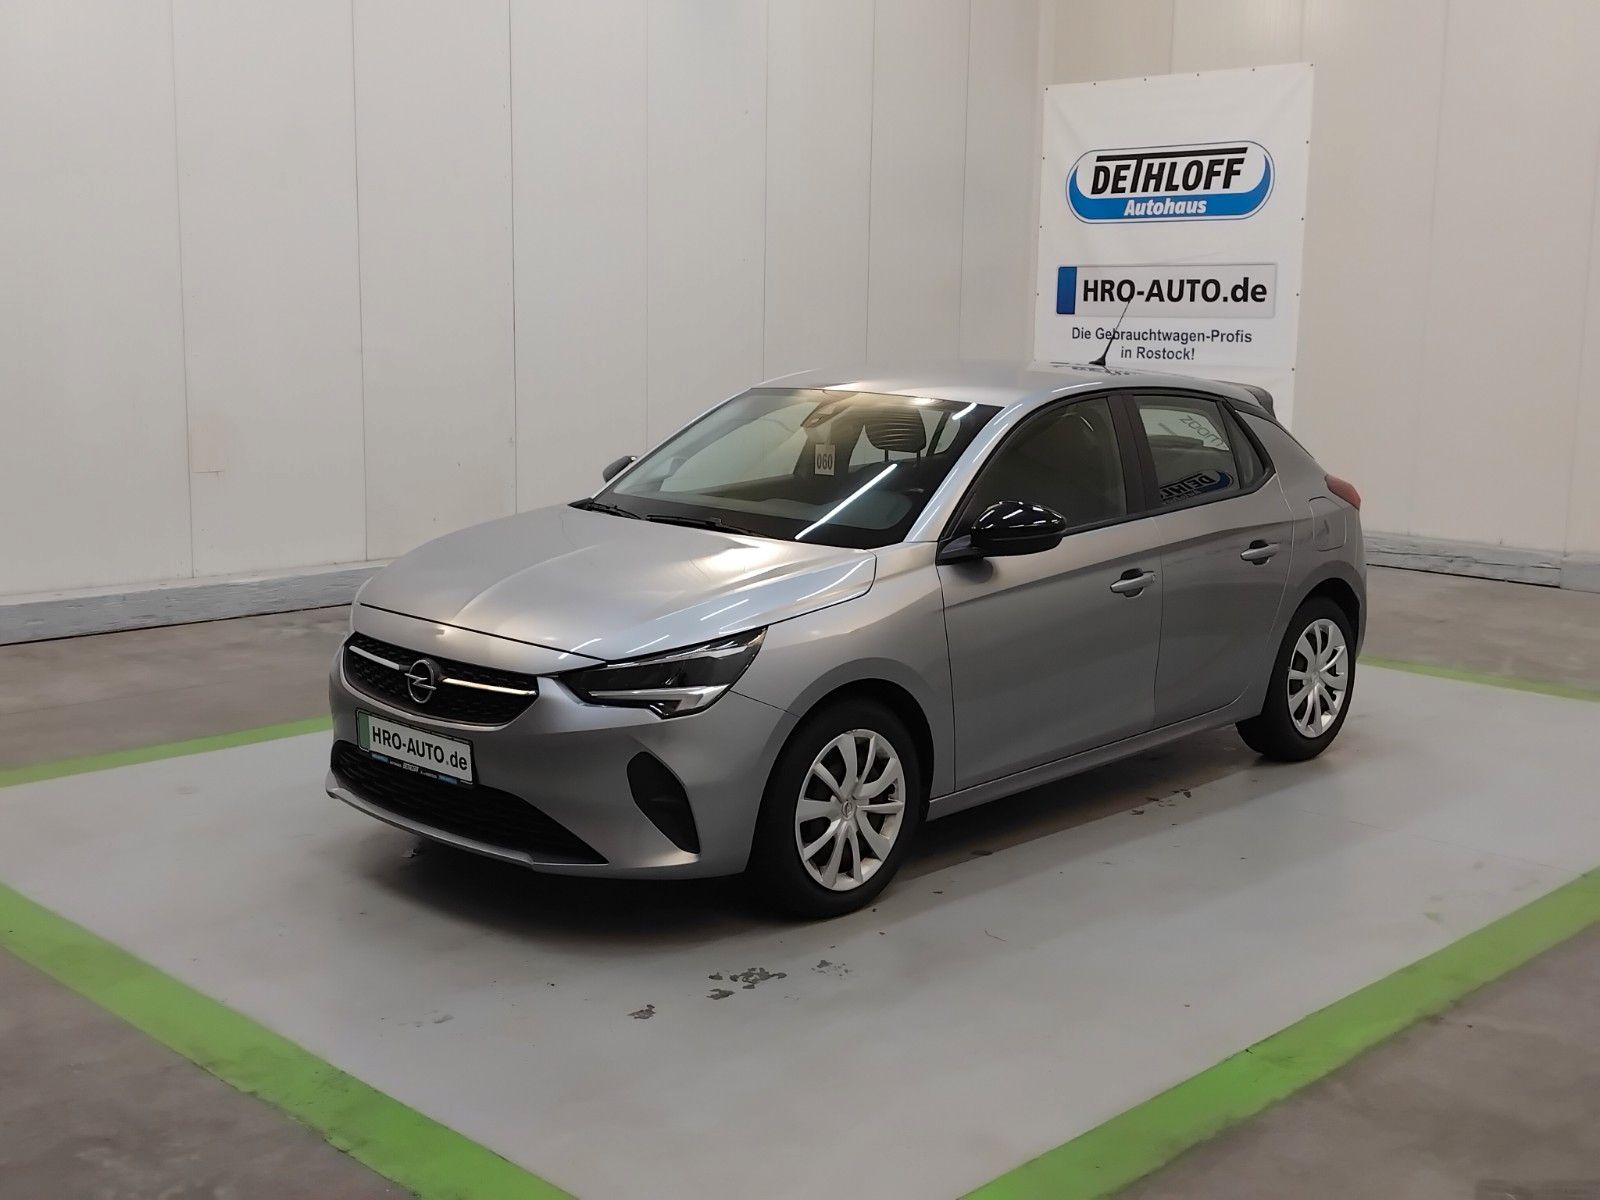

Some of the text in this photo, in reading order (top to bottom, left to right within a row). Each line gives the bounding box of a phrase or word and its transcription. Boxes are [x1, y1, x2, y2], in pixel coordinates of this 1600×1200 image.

[1090, 147, 1248, 195] DETHLOFF
[1123, 198, 1207, 217] Autohaus
[1082, 277, 1268, 304] HRO-AUTO.de
[1071, 327, 1253, 344] Die Gebrauchtwagen-Profis
[1120, 345, 1195, 361] in Rostock!
[372, 725, 468, 771] HRO-AUTO.de
